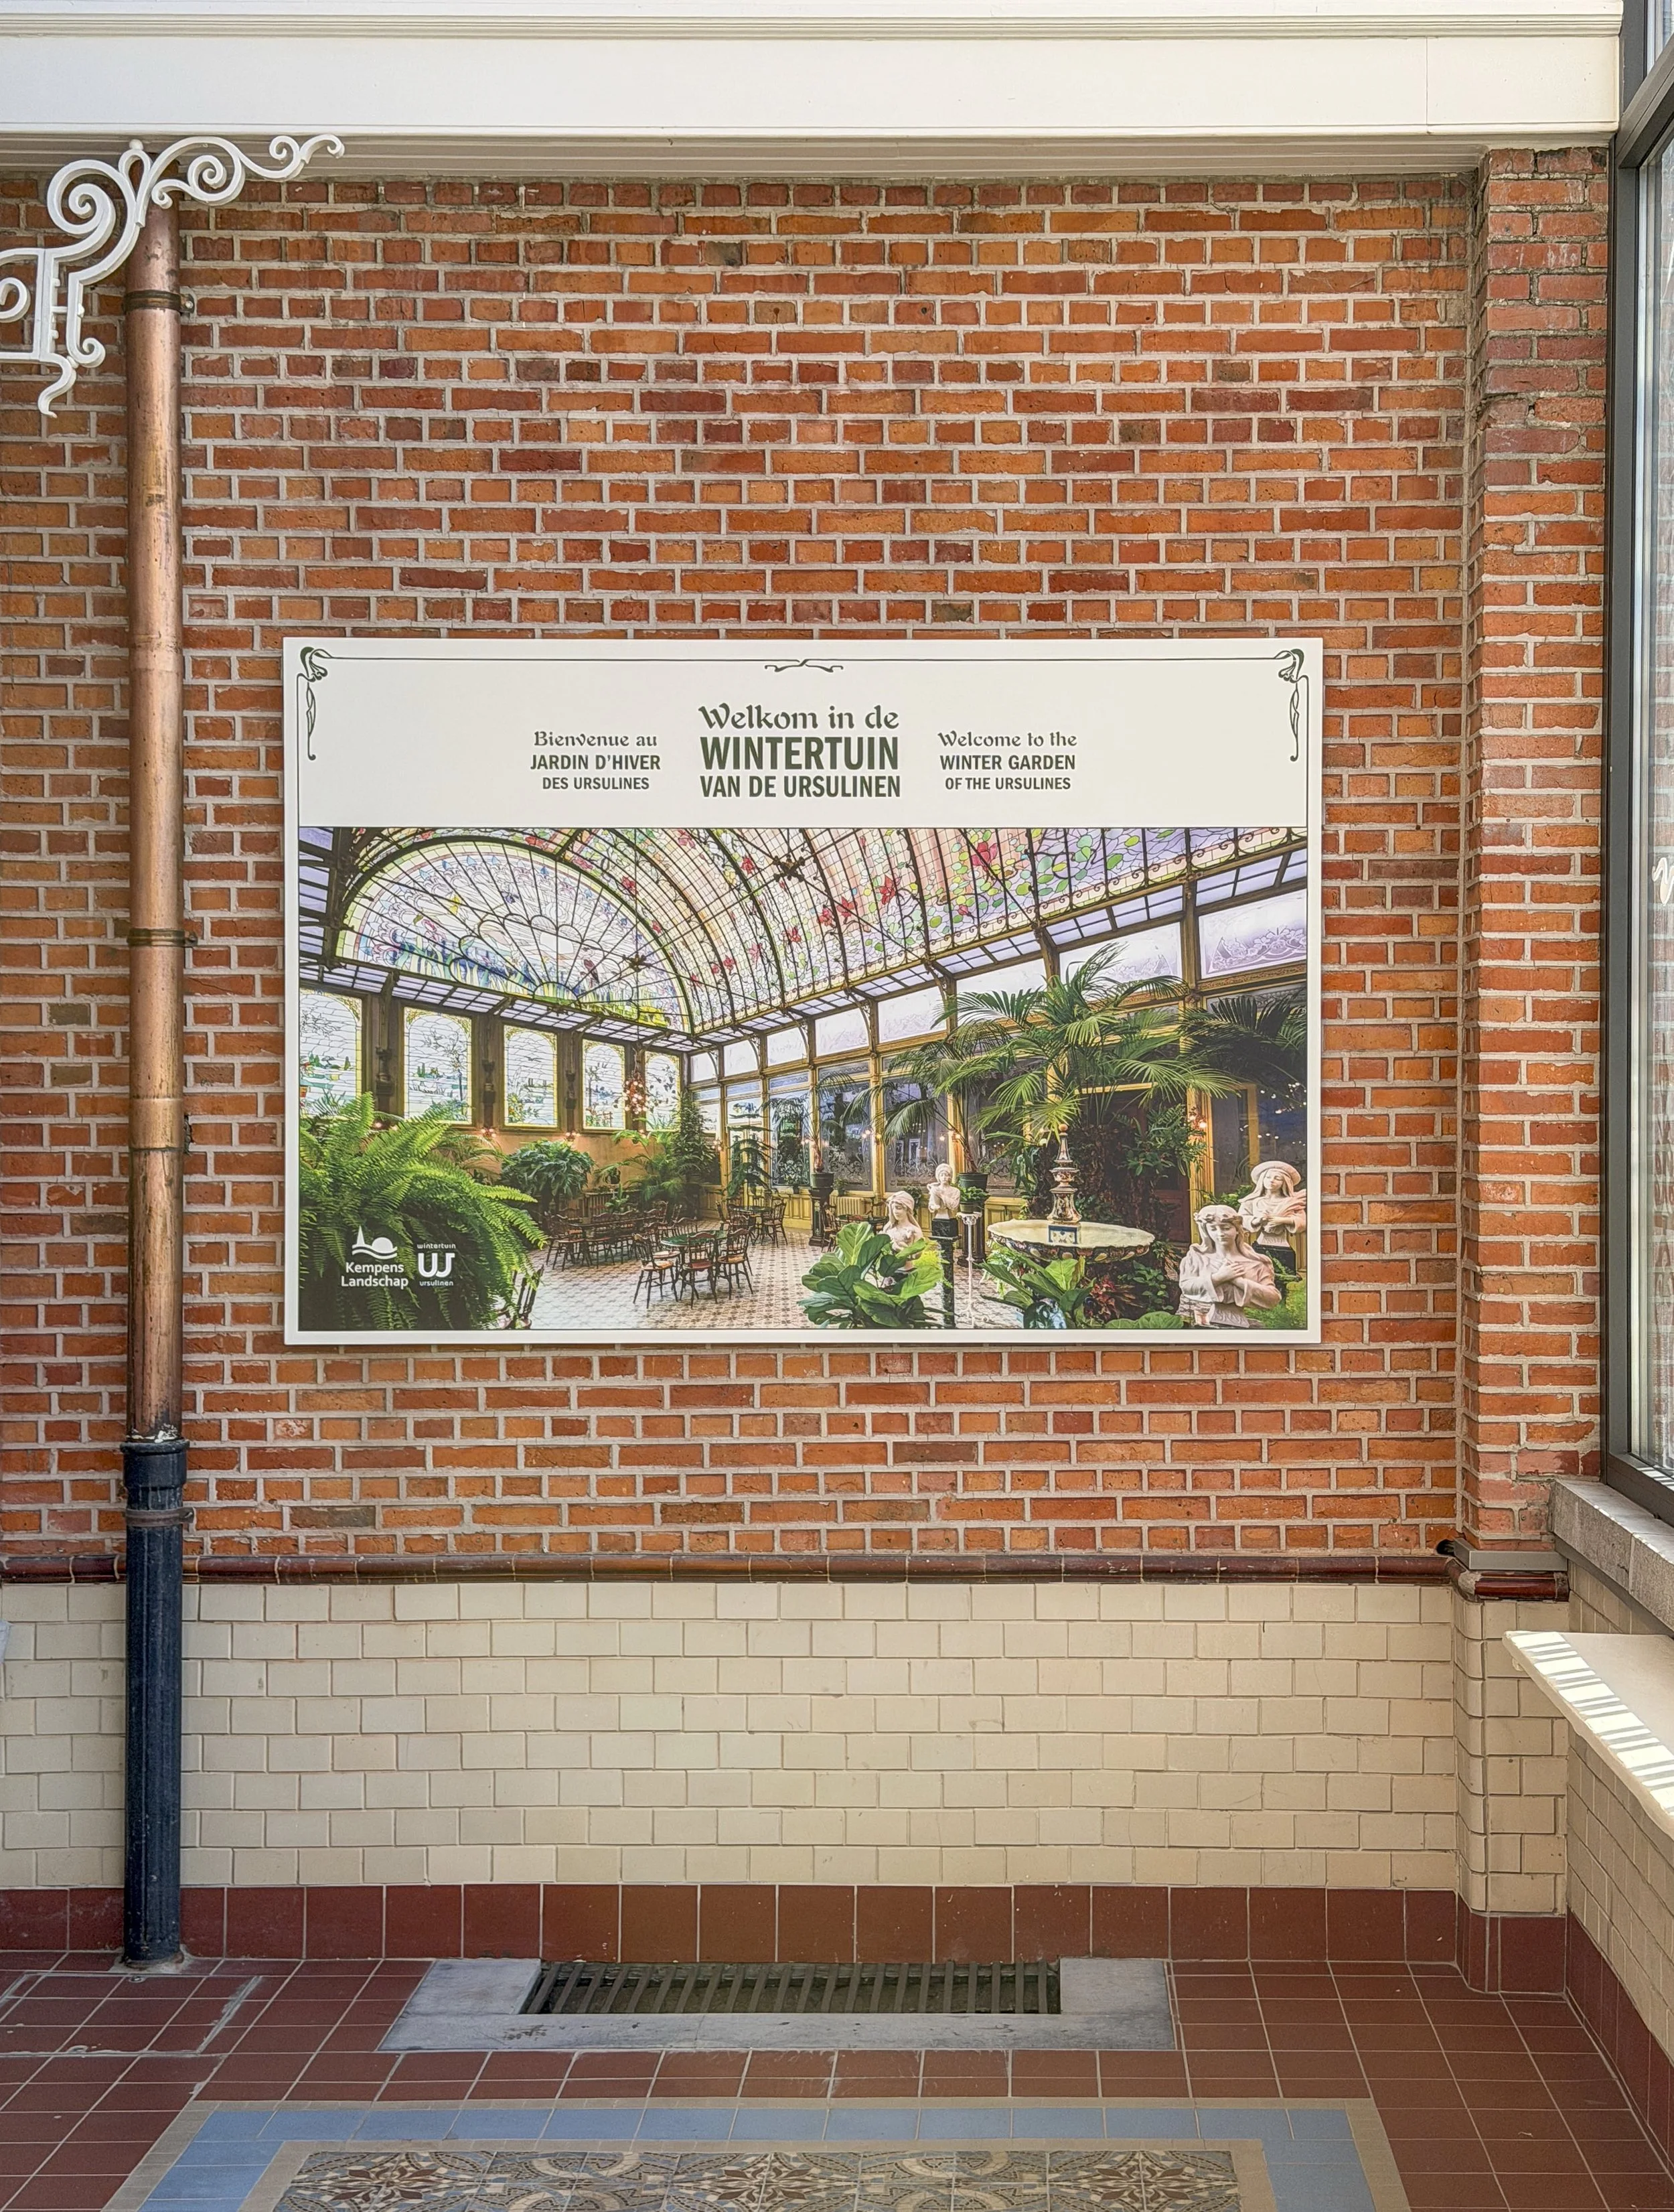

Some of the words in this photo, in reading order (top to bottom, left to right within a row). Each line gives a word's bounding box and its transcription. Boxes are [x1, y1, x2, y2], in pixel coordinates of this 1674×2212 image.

[698, 703, 818, 730] Welkom
[828, 705, 854, 729] in
[864, 705, 899, 729] de
[534, 731, 629, 747] Bienvenue
[635, 736, 658, 747] au
[937, 730, 1021, 747] Welcome
[1027, 732, 1044, 747] to
[1049, 731, 1077, 747] the
[700, 736, 899, 770] WINTERTUIN
[530, 754, 589, 770] JARDIN
[939, 755, 1002, 770] WINTER
[1008, 755, 1075, 770] GARDEN
[542, 777, 568, 790] DES
[573, 777, 650, 790] URSULINES
[700, 776, 741, 798] VAN
[749, 776, 777, 798] DE
[783, 775, 901, 798] URSULINEN
[945, 777, 964, 790] OF
[966, 777, 991, 790] THE
[995, 777, 1071, 790] URSULINES
[346, 1262, 404, 1276] Kempens
[341, 1275, 409, 1289] Landschap
